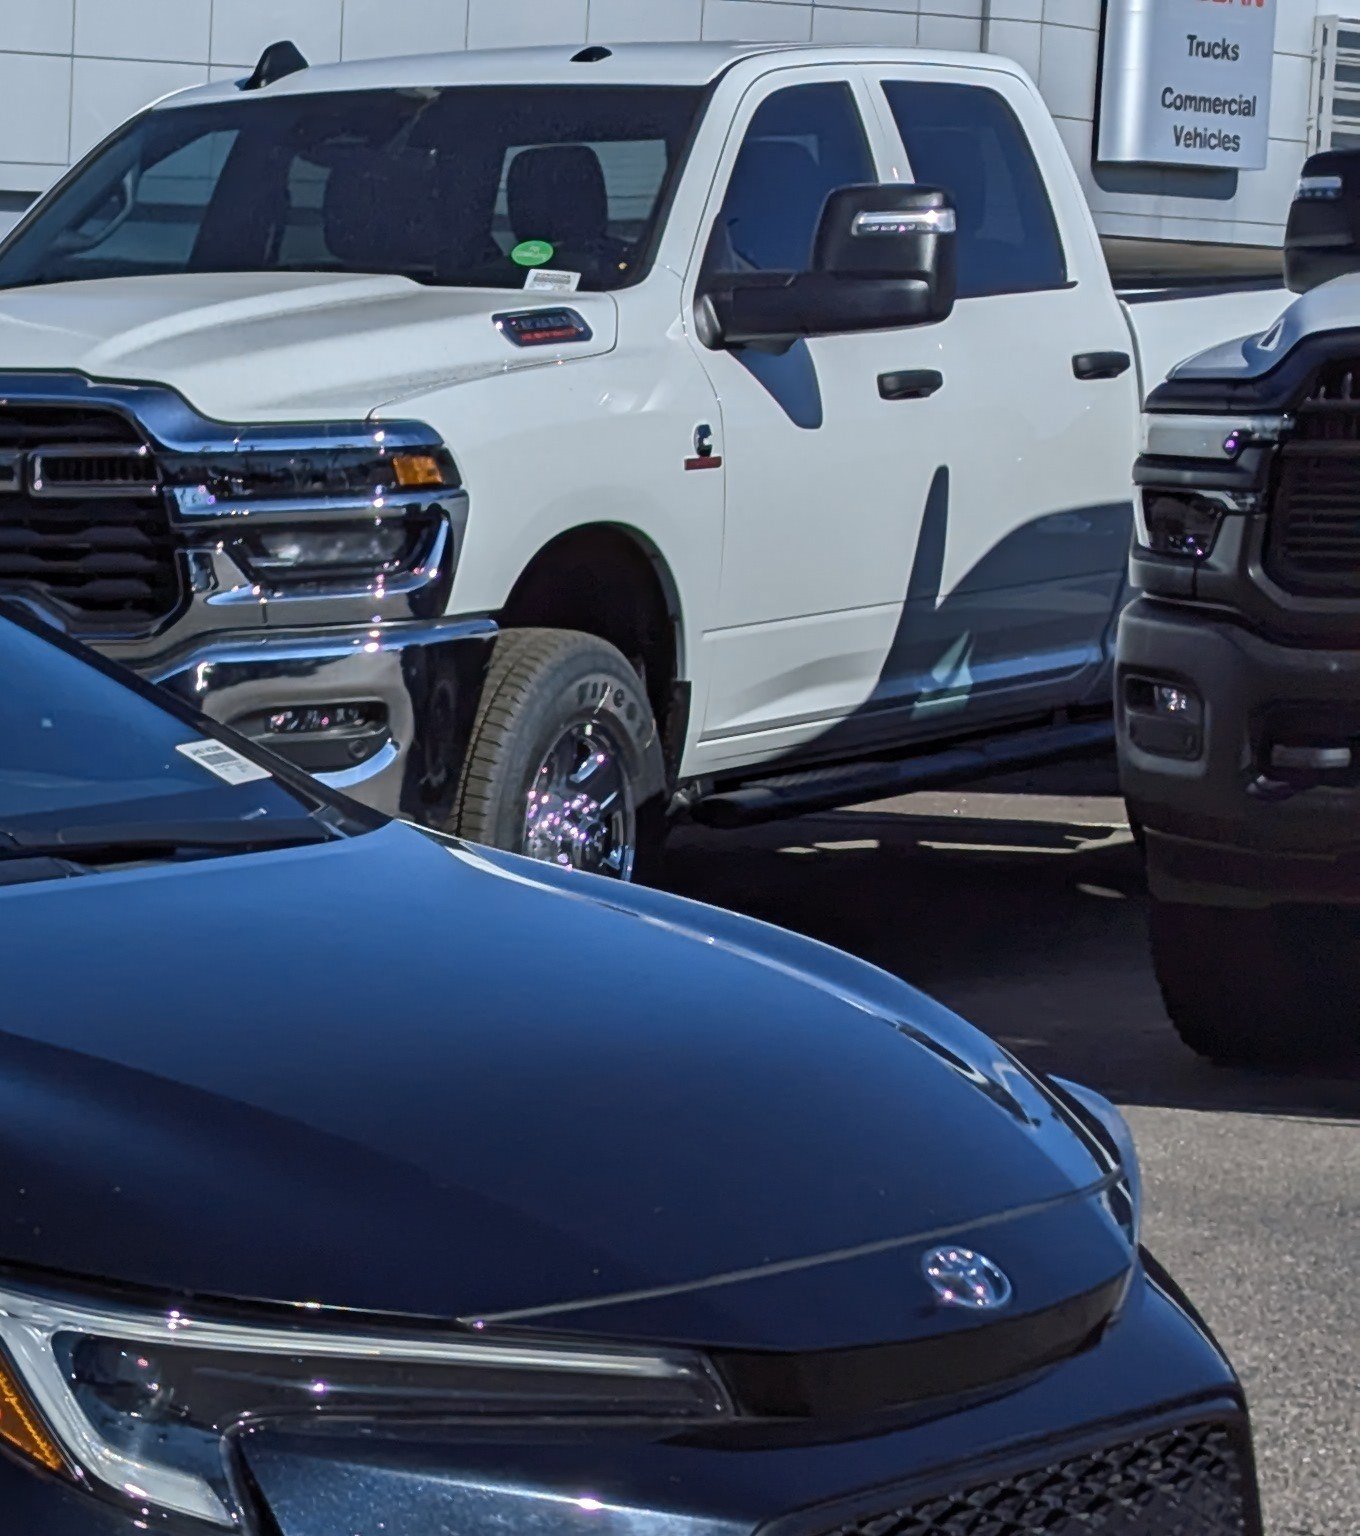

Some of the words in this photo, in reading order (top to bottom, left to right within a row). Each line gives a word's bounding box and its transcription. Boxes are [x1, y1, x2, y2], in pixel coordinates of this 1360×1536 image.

[1187, 34, 1240, 62] Trucks
[1161, 87, 1256, 117] Commercial
[1173, 125, 1241, 152] Vehicles
